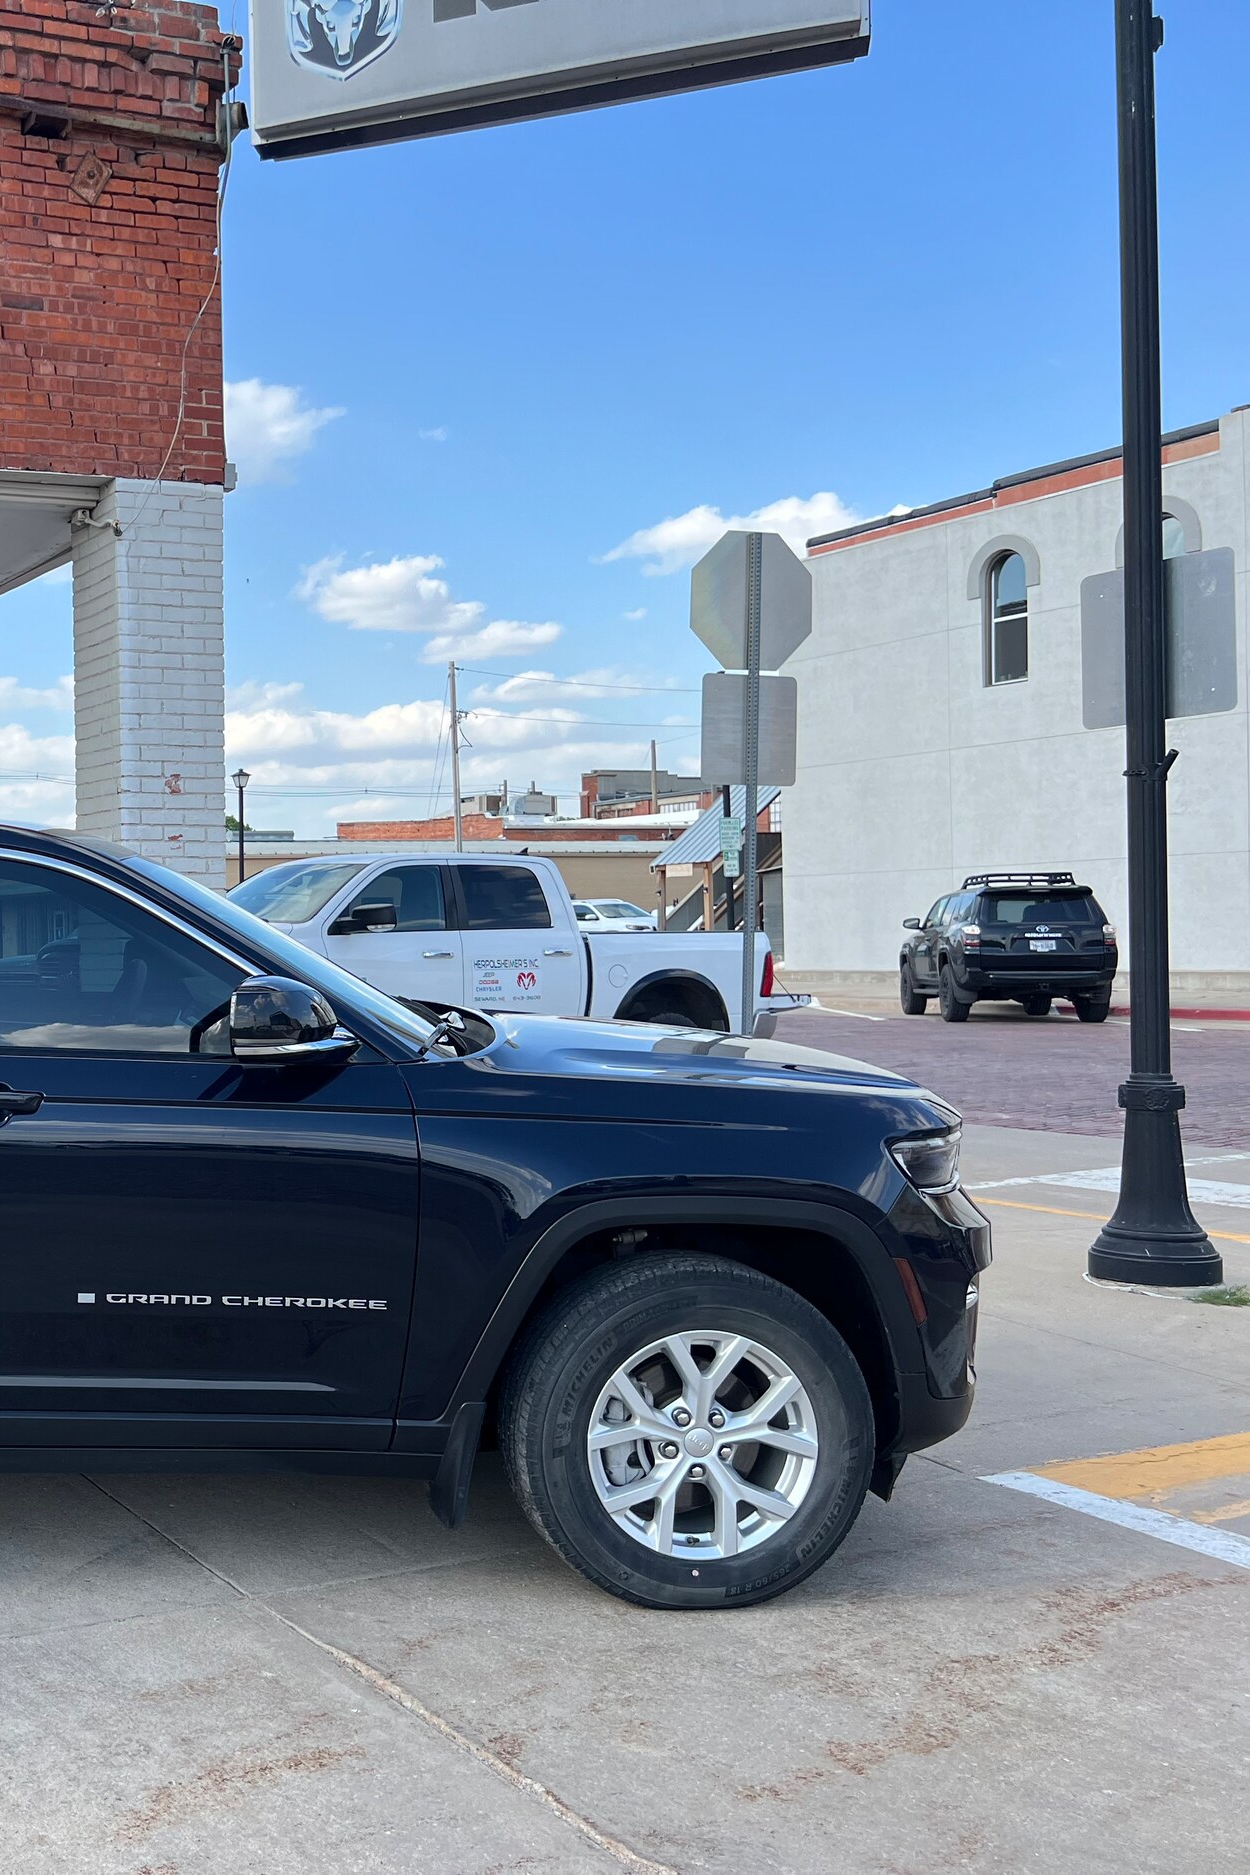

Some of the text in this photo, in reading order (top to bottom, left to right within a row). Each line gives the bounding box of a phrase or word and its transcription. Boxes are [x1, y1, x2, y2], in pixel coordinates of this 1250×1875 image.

[106, 1293, 388, 1310] GRAND CHEROKEE
[561, 1335, 616, 1418] MICHELIN
[800, 1477, 853, 1560] MICHELIN
[730, 1563, 791, 1595] 265/60 R 18
